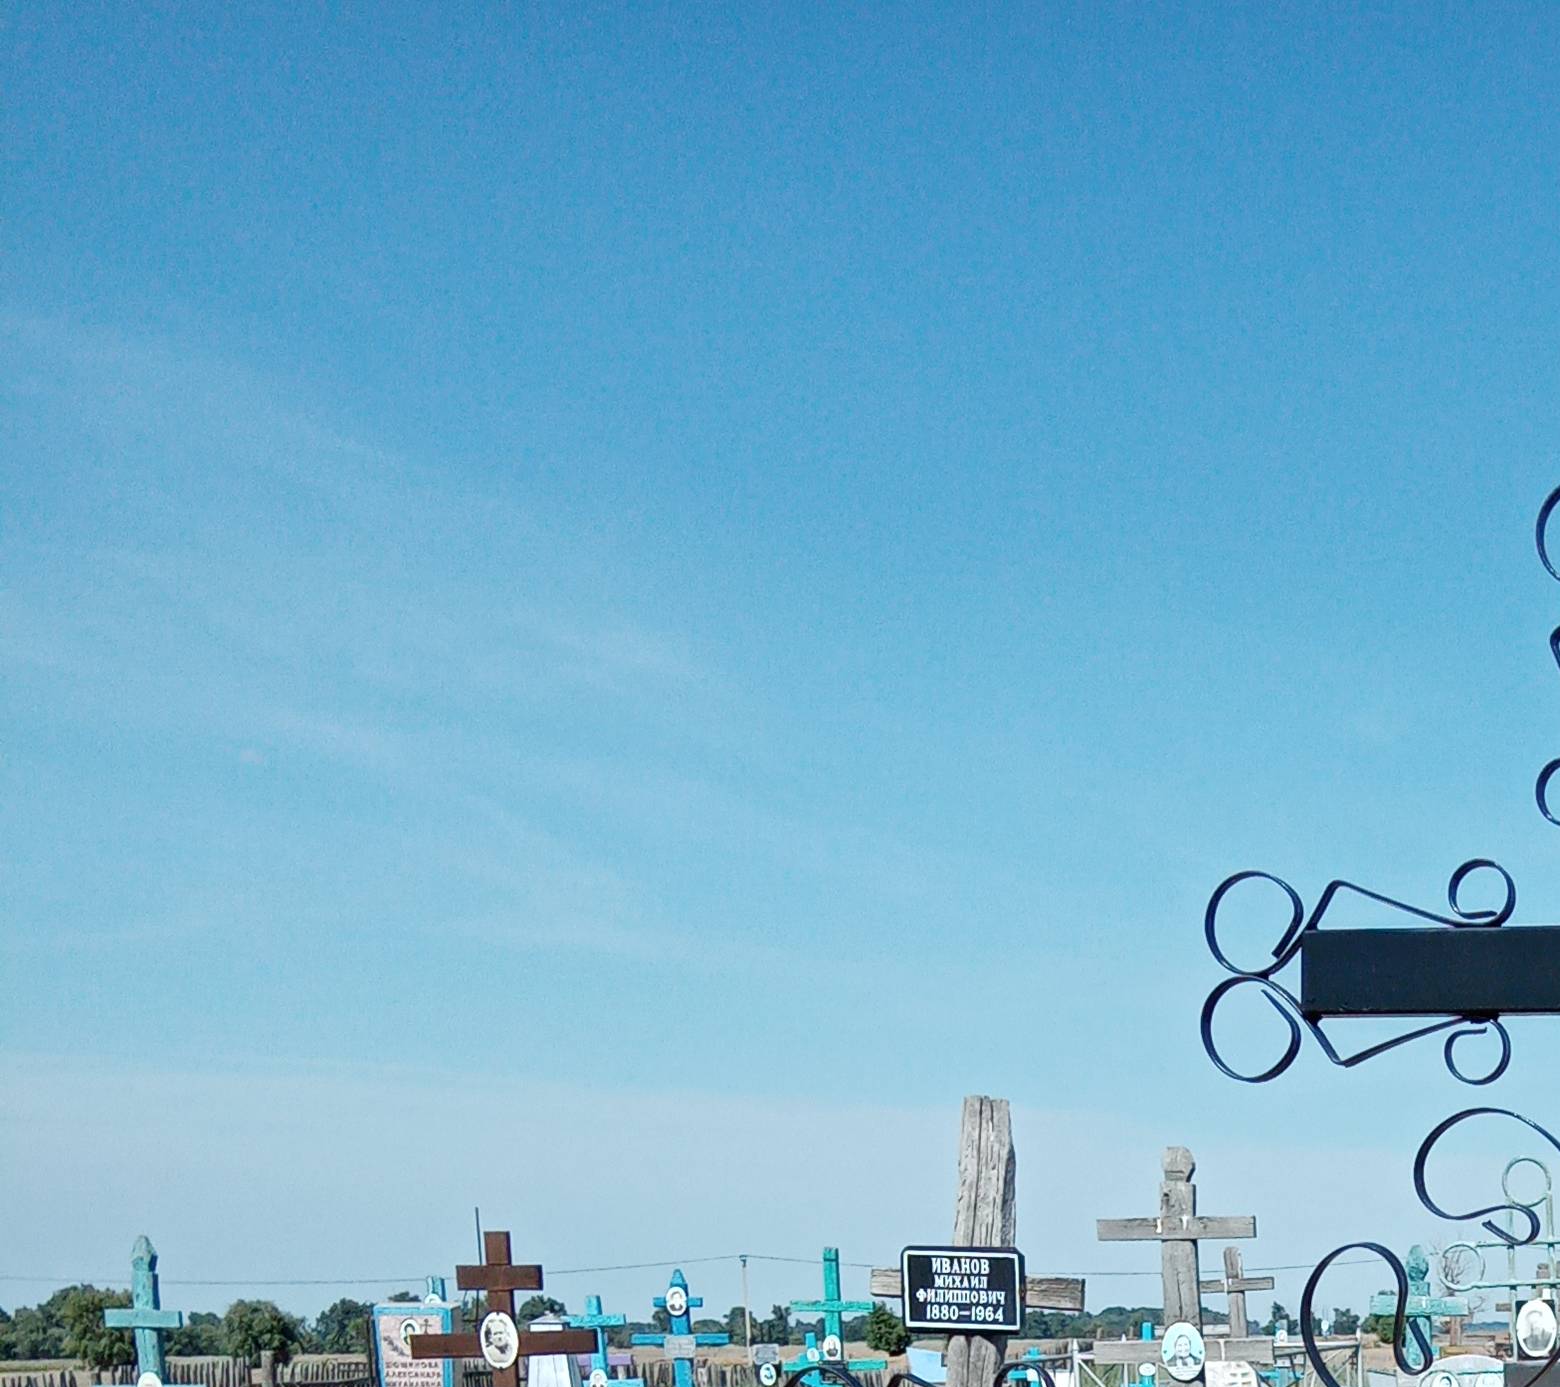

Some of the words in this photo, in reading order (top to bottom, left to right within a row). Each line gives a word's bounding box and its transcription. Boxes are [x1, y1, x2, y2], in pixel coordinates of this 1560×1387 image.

[931, 1257, 990, 1275] ИВАНОВ
[934, 1274, 988, 1289] МИХАИЛ
[915, 1288, 1006, 1305] ФИЛИППОВИЧ
